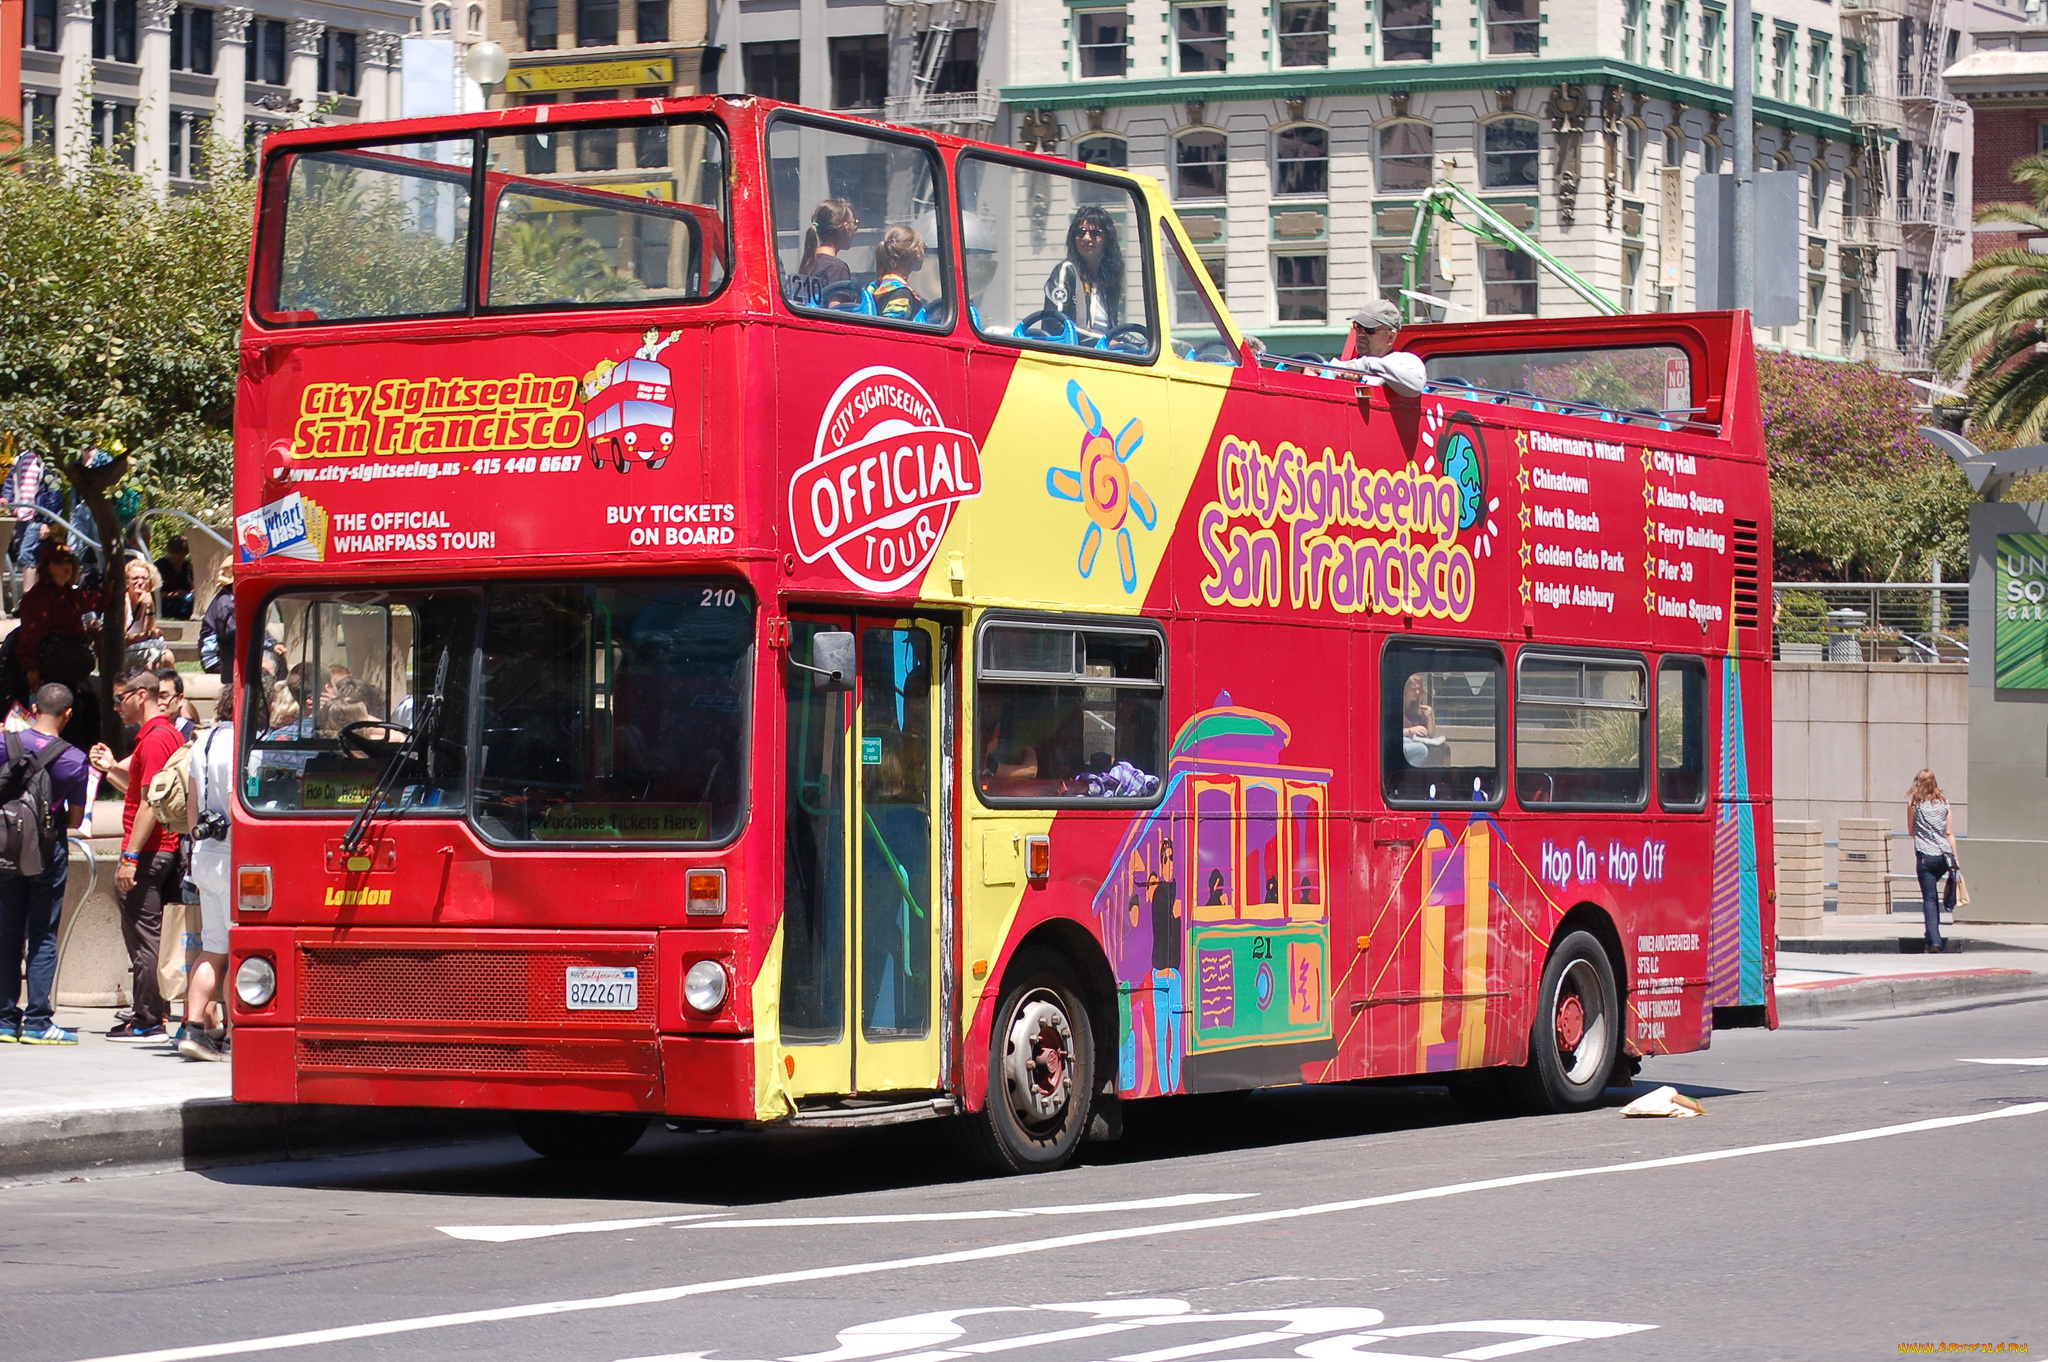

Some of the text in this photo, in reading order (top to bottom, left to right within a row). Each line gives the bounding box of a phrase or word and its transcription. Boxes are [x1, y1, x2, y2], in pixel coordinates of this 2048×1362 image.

[791, 275, 822, 305] 210
[303, 374, 578, 420] City Sightseeing
[831, 385, 931, 447] CITY SIGHTSEEING
[293, 409, 583, 456] San Francisco
[1530, 431, 1625, 462] Fisherman's Wharf
[472, 458, 500, 474] 415
[504, 457, 537, 473] 440
[539, 455, 582, 472] 8687
[1654, 451, 1696, 477] City Hall
[811, 441, 973, 537] OFFICIAL
[1533, 467, 1588, 494] Chinatown
[607, 504, 734, 524] BUY TICKETS
[1657, 487, 1724, 516] Alamo Square
[265, 502, 300, 530] wharf
[334, 513, 366, 531] THE
[370, 510, 450, 529] OFFICIAL
[1535, 505, 1599, 533] North Beach
[269, 518, 304, 548] pass
[334, 531, 496, 554] WHARFPASS TOUR!
[630, 526, 734, 545] ON BOARD
[865, 515, 936, 573] TOUR
[1658, 523, 1725, 554] Ferry Building
[1200, 507, 1473, 618] San Francisco
[1535, 543, 1625, 572] Golden Gate Park
[1658, 559, 1693, 582] Pier 39
[700, 588, 736, 607] 210
[1535, 582, 1614, 613] Haight Ashbury
[1658, 596, 1722, 623] Union Square
[543, 814, 698, 830] Purchase Tickets Here
[1541, 840, 1666, 887] Hop On Hop Off
[324, 886, 392, 906] London
[1252, 936, 1272, 959] 21
[581, 969, 622, 982] California
[571, 983, 632, 1004] 8Z22677
